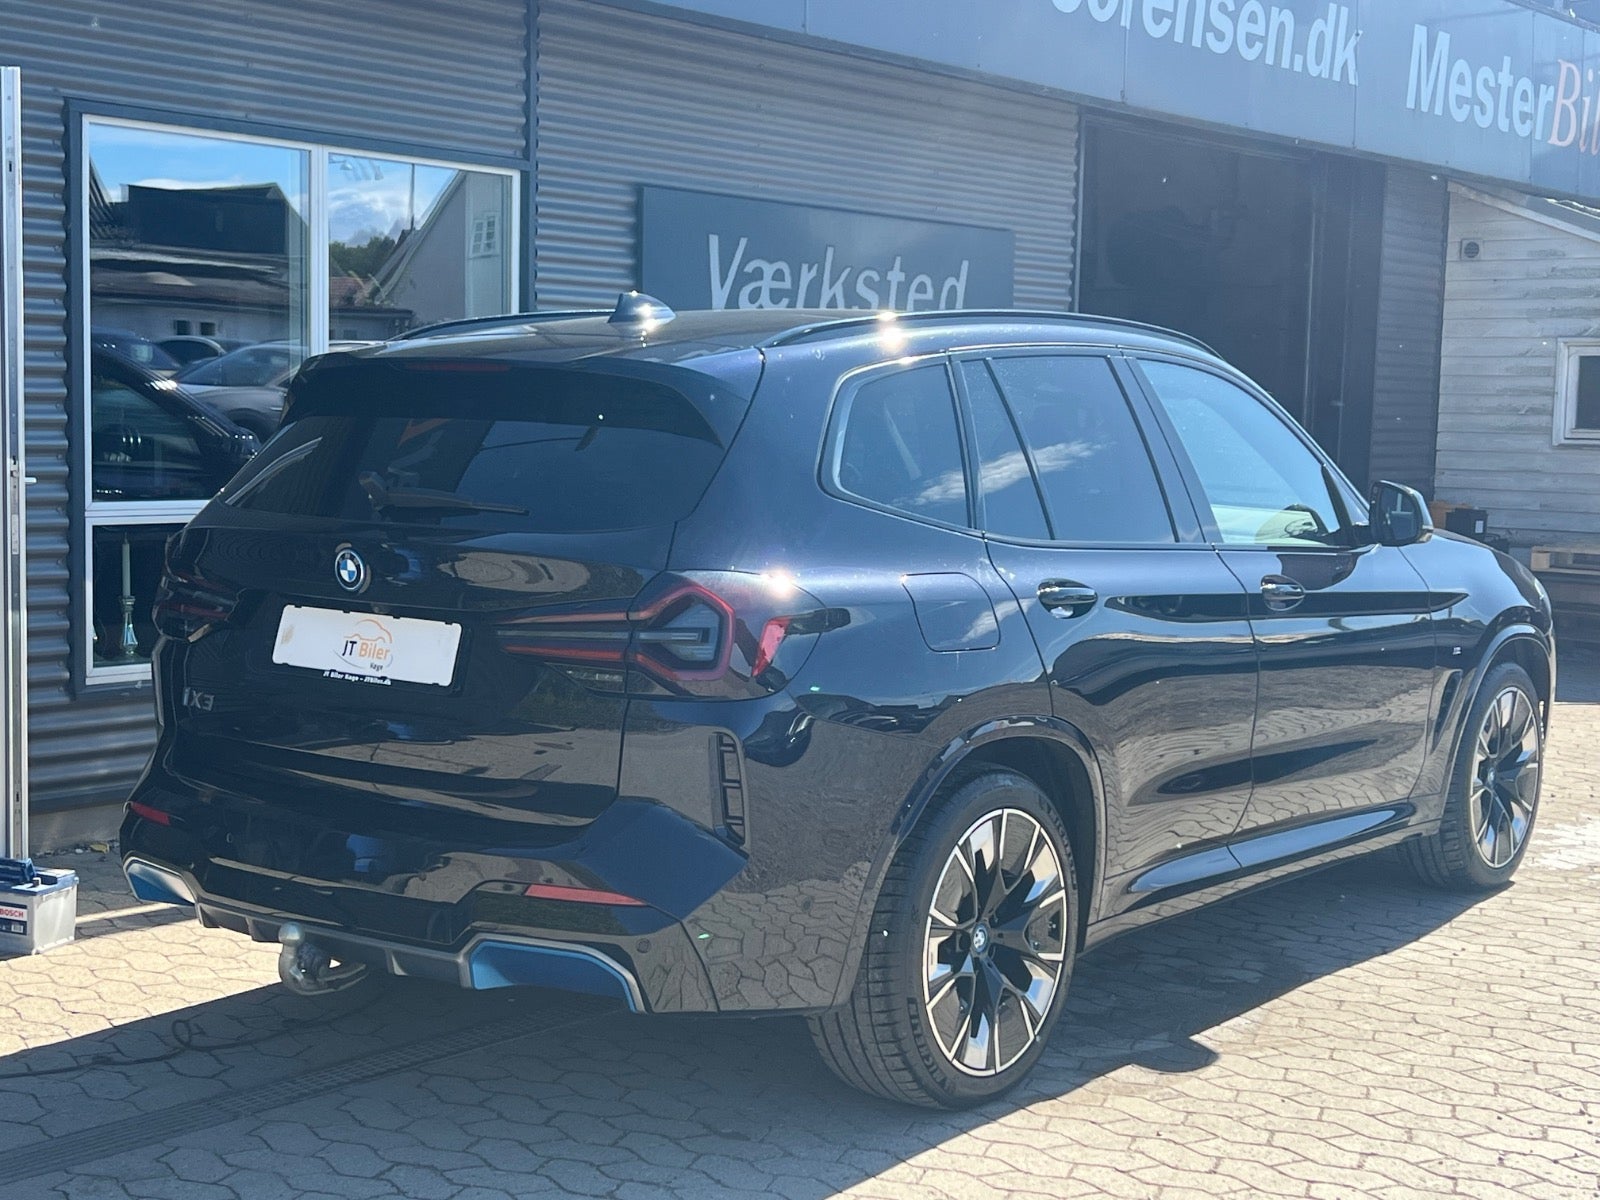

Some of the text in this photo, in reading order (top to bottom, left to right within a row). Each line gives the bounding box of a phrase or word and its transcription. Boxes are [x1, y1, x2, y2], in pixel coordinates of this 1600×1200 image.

[1052, 0, 1363, 86] ensen.dk
[708, 234, 969, 311] Værksted
[341, 639, 390, 660] JT Biler
[0, 909, 24, 918] BOSCH
